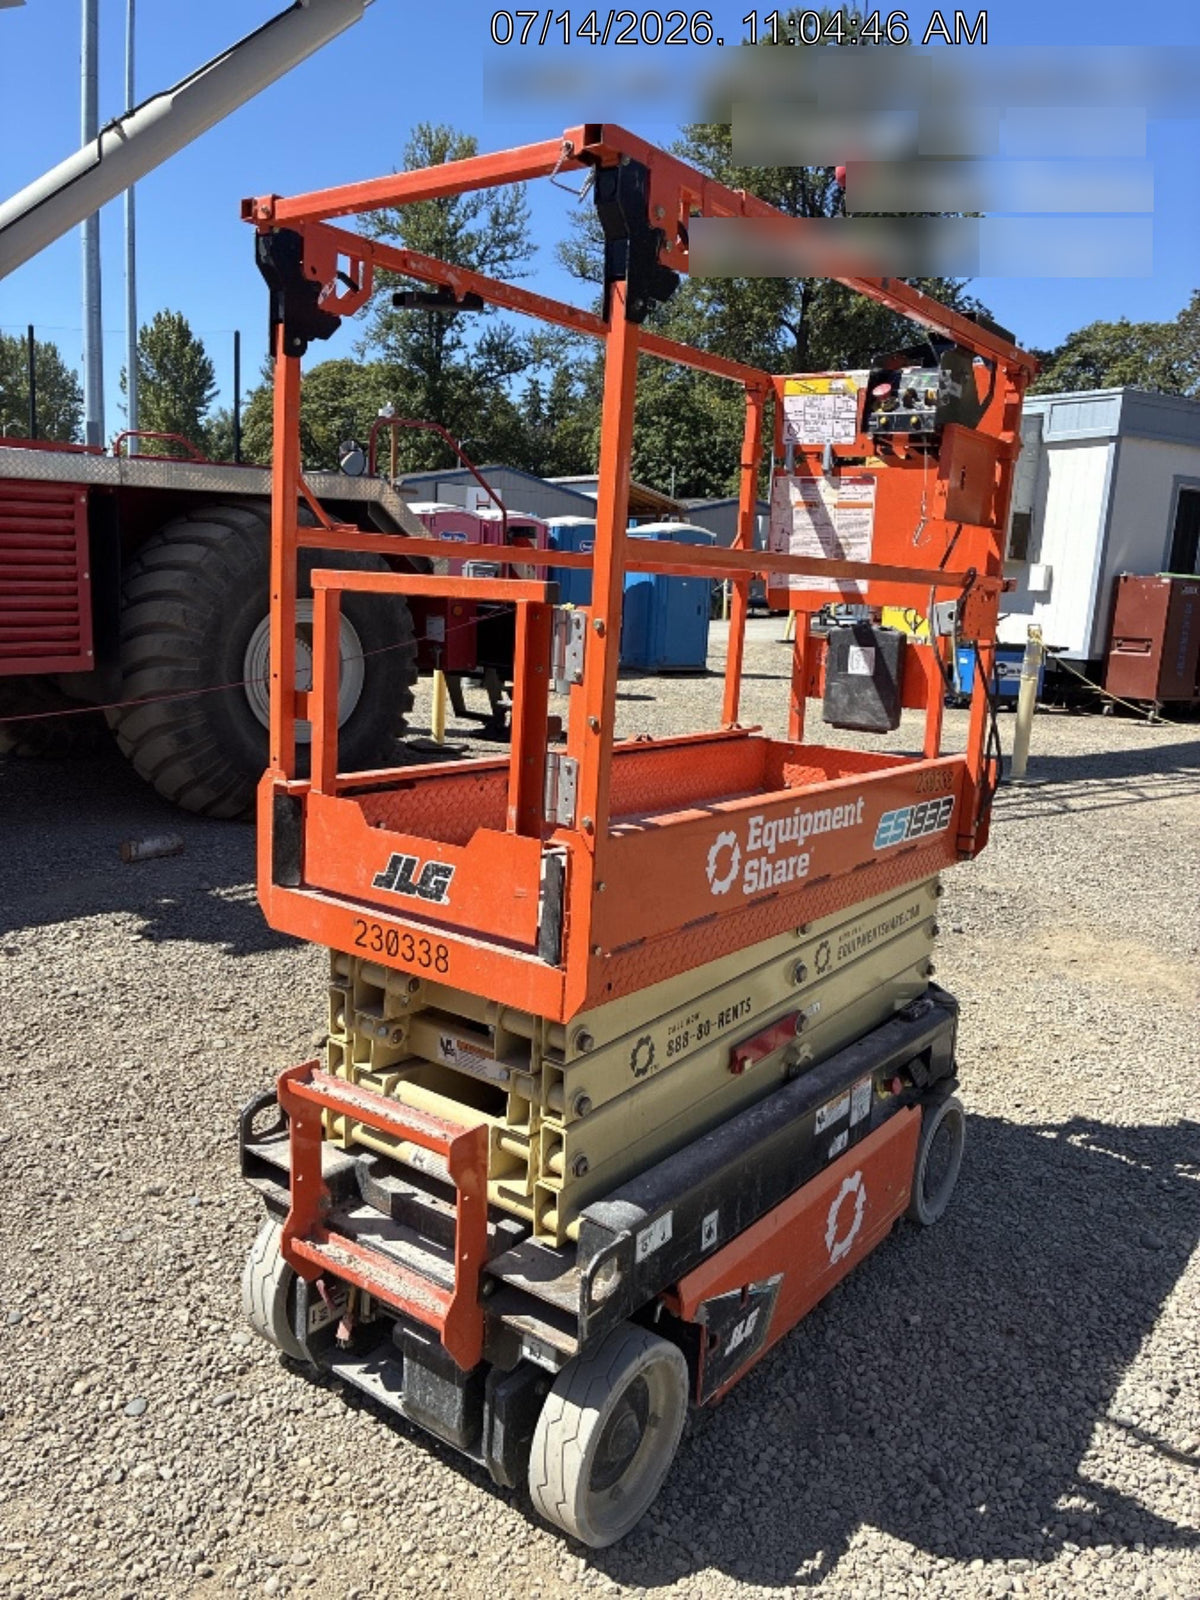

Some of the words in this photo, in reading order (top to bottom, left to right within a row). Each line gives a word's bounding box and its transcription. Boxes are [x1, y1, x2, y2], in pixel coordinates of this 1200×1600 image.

[746, 796, 866, 854] Equipment
[873, 794, 956, 850] ES1932
[371, 852, 456, 906] JLG
[742, 853, 811, 895] Share
[354, 919, 450, 973] 230338
[666, 997, 752, 1057] 888-80-RENTS
[723, 1306, 761, 1357] JLG
